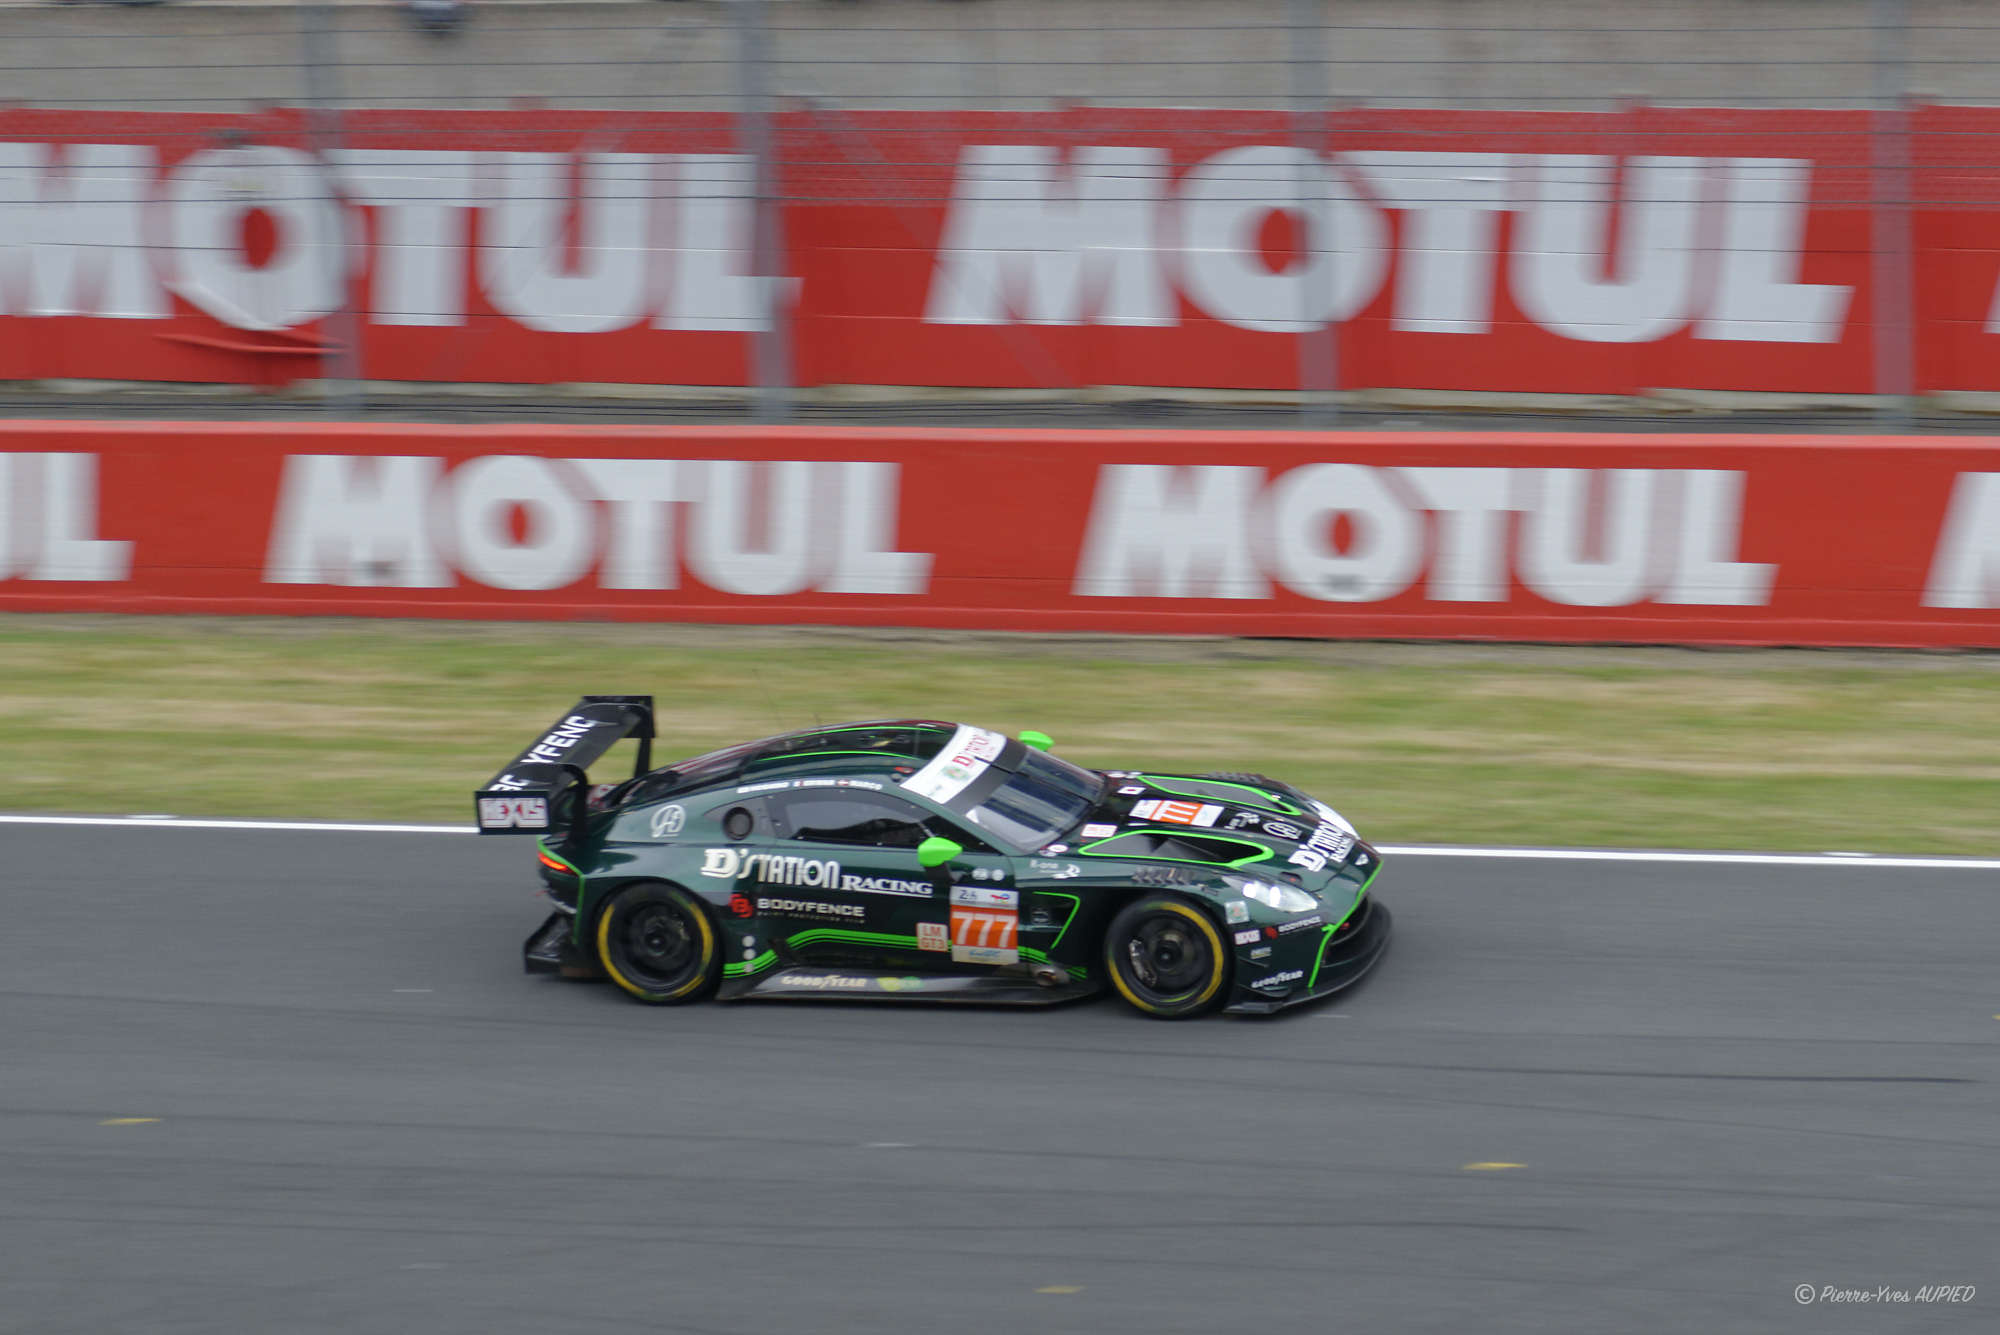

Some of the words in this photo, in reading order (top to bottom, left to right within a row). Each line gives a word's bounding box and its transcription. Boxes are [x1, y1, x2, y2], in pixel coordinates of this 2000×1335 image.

[922, 143, 1855, 344] MOTUL
[262, 453, 936, 596] MOTUL
[1072, 462, 1779, 607] MOTUL
[840, 874, 934, 897] RACING
[757, 898, 865, 917] BODYFENCE
[922, 925, 942, 937] LM
[952, 911, 1017, 948] 777
[781, 975, 868, 989] GOODYEAR
